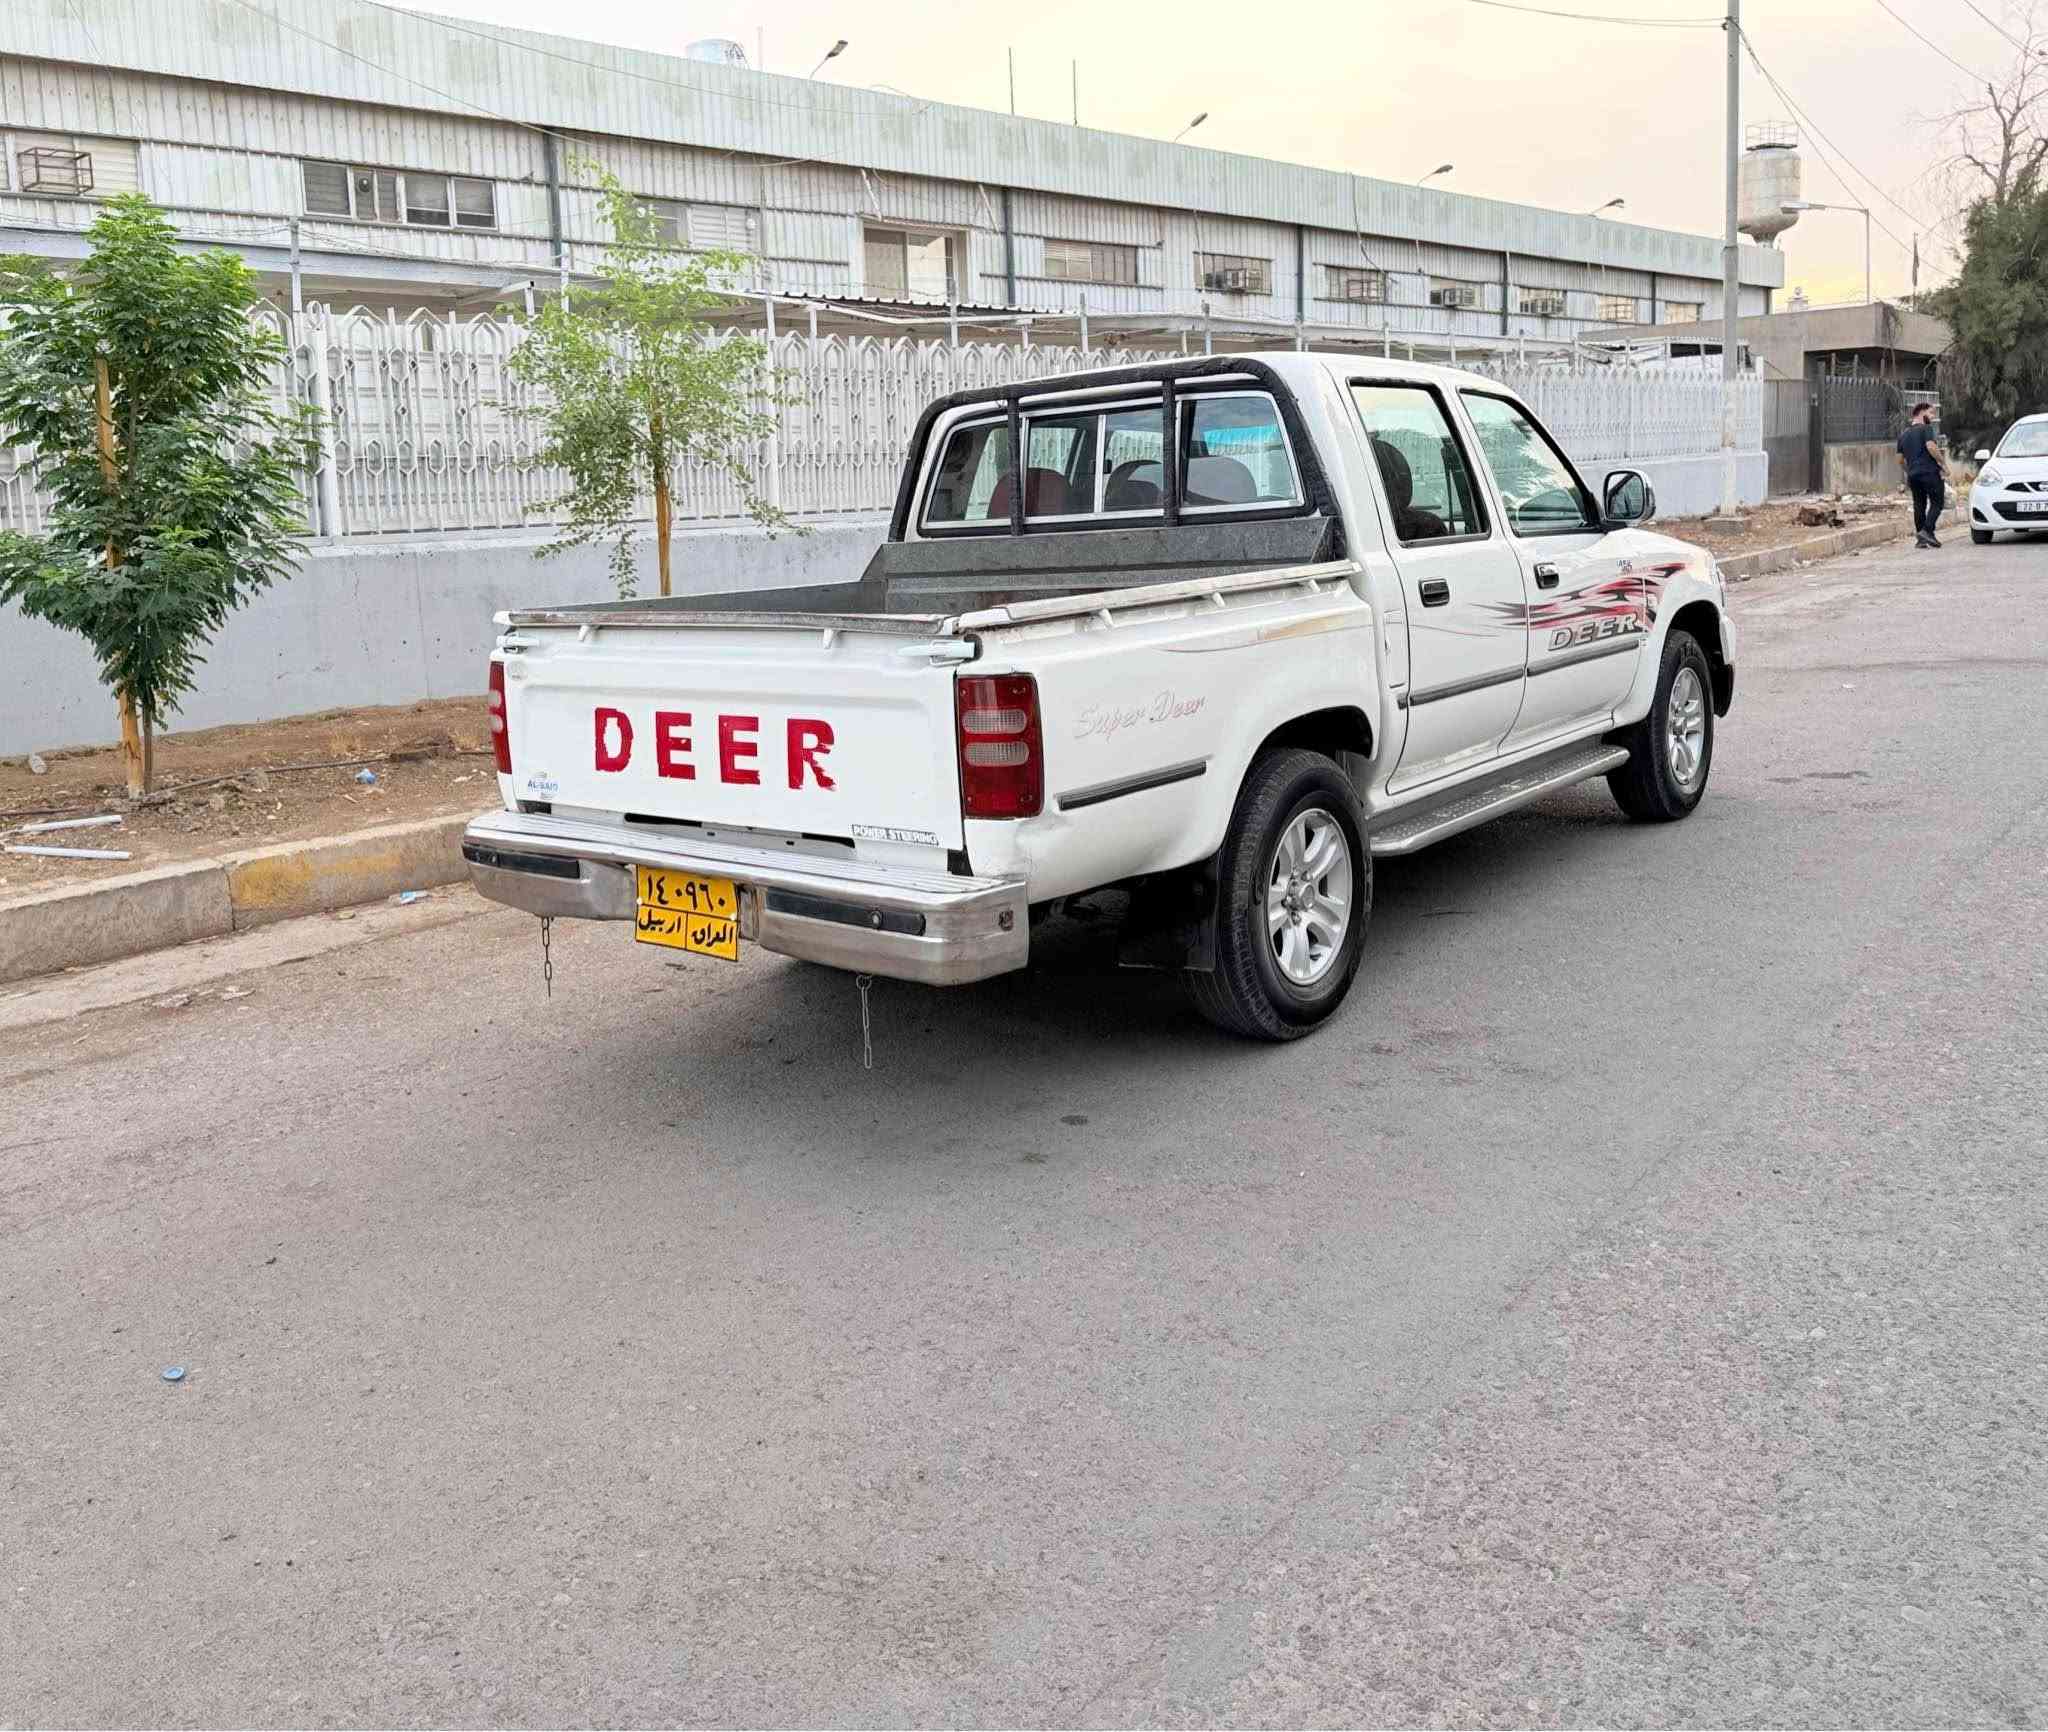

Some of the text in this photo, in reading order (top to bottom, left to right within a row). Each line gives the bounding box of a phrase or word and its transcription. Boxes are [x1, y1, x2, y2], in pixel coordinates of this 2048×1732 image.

[1549, 613, 1642, 651] DEER
[1073, 686, 1206, 744] Super Deer
[594, 706, 837, 791] DEER
[852, 824, 938, 846] POWER STEERING
[638, 908, 682, 935] اربيل
